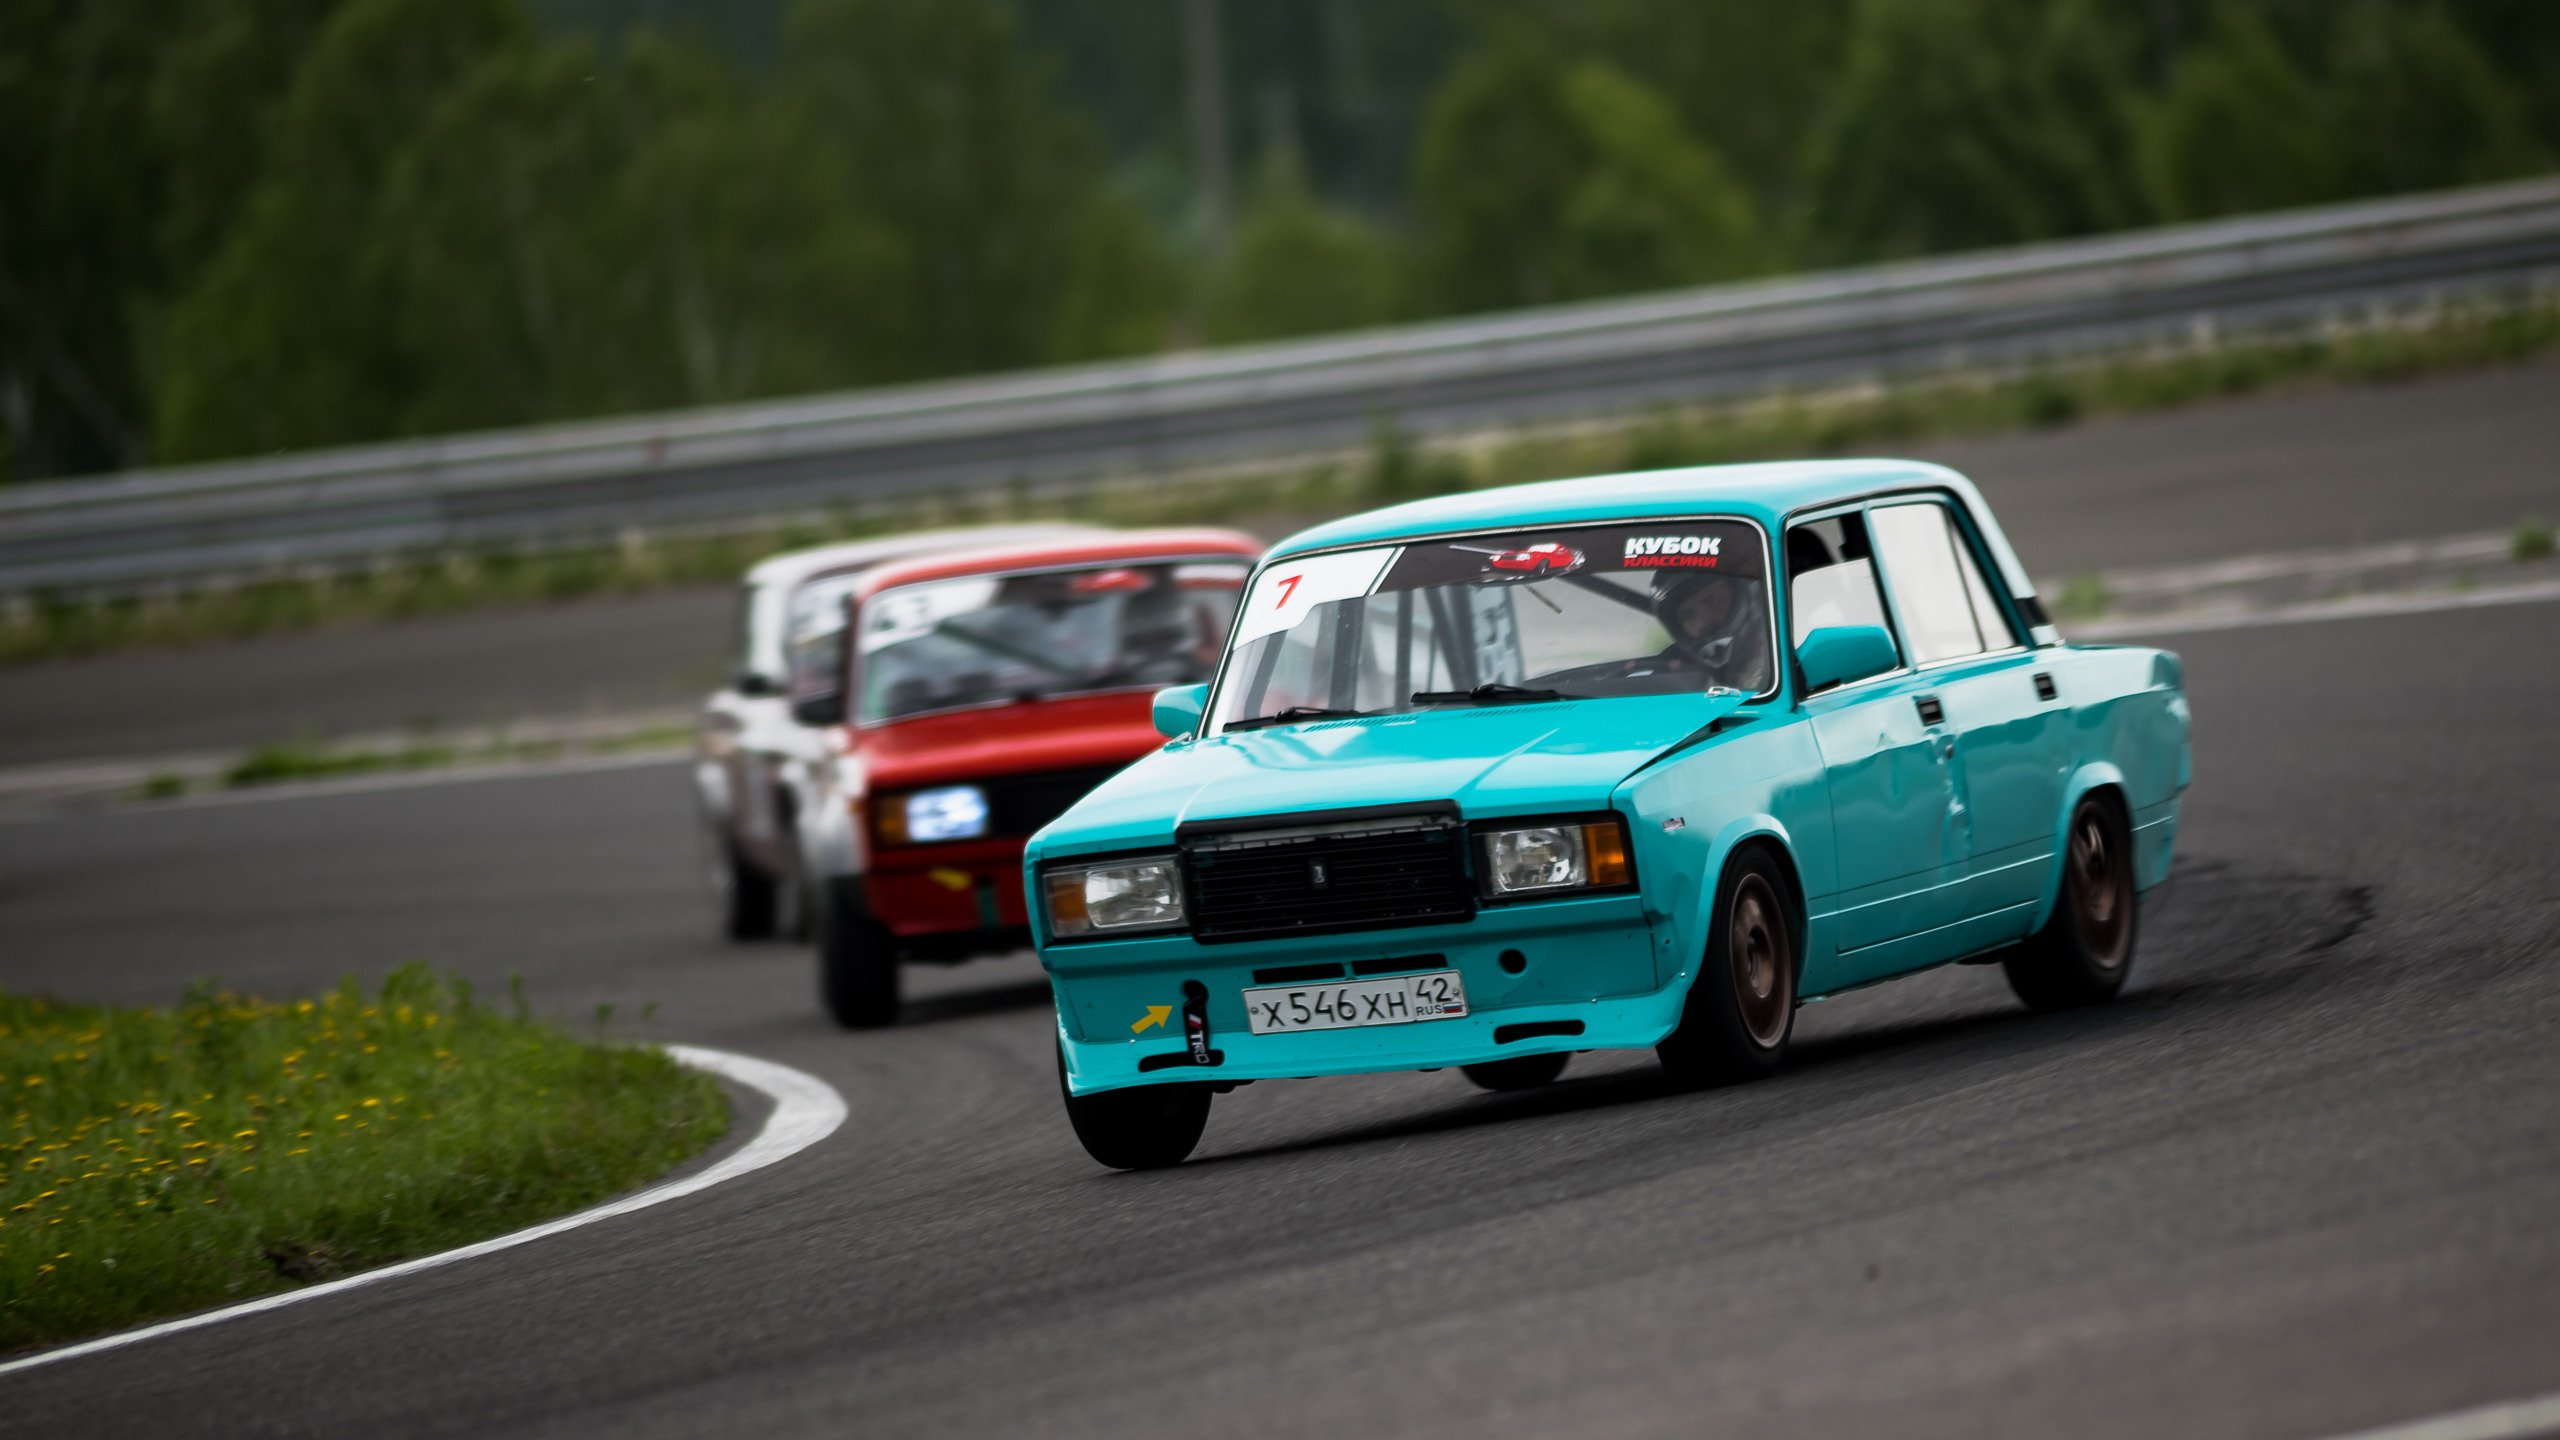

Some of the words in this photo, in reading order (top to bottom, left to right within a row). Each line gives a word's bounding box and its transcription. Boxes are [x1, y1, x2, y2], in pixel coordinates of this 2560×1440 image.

[1625, 537, 1721, 555] КУБОК
[1624, 555, 1717, 568] КЛАССИКИ
[1275, 574, 1303, 610] 7
[1416, 977, 1451, 1003] 42
[1416, 1004, 1443, 1016] RUS
